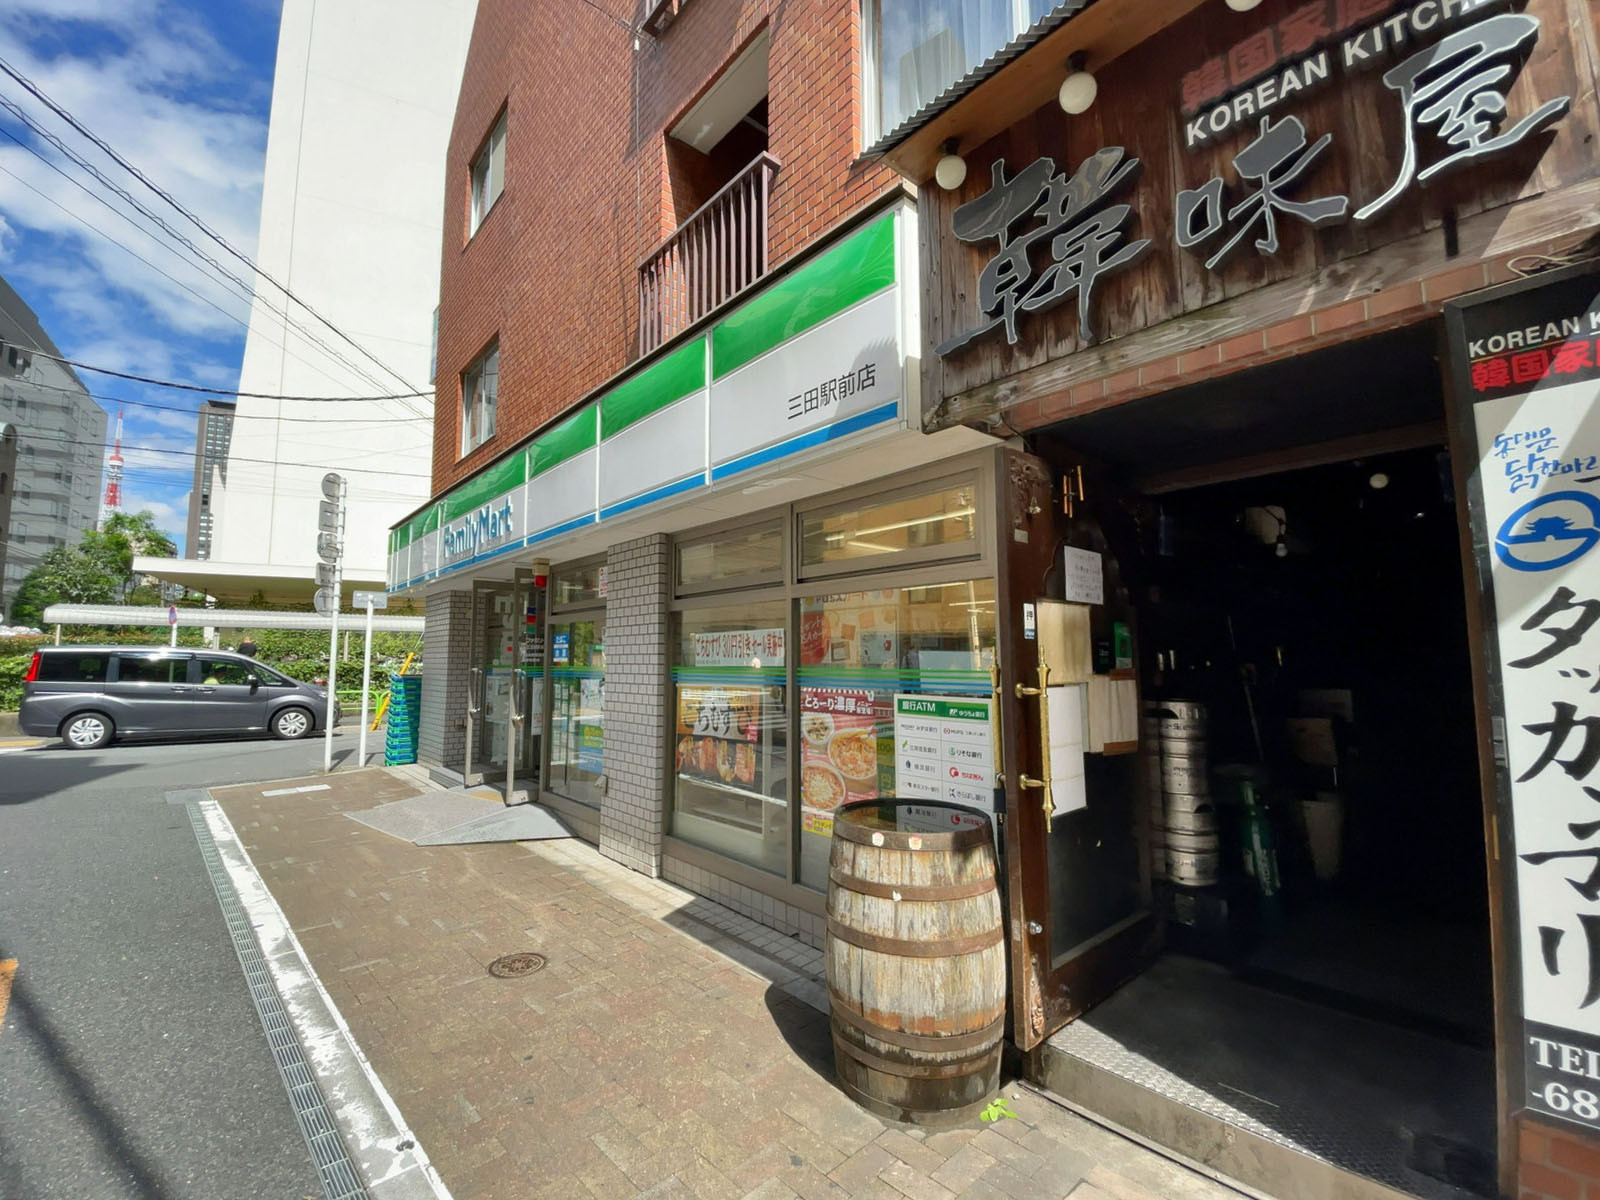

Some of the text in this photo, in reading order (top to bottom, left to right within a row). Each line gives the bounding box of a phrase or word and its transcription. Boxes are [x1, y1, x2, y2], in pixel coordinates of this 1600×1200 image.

[1187, 0, 1480, 146] KOREAN KITCH
[934, 14, 1570, 356] 韓味屋
[1469, 317, 1580, 358] KOREAN
[1472, 338, 1600, 391] 韓国家
[788, 363, 875, 420] 三田駅前店
[444, 496, 513, 558] FamilyMart
[805, 694, 856, 714] とろーり濃厚
[902, 700, 936, 712] 銀行ATM
